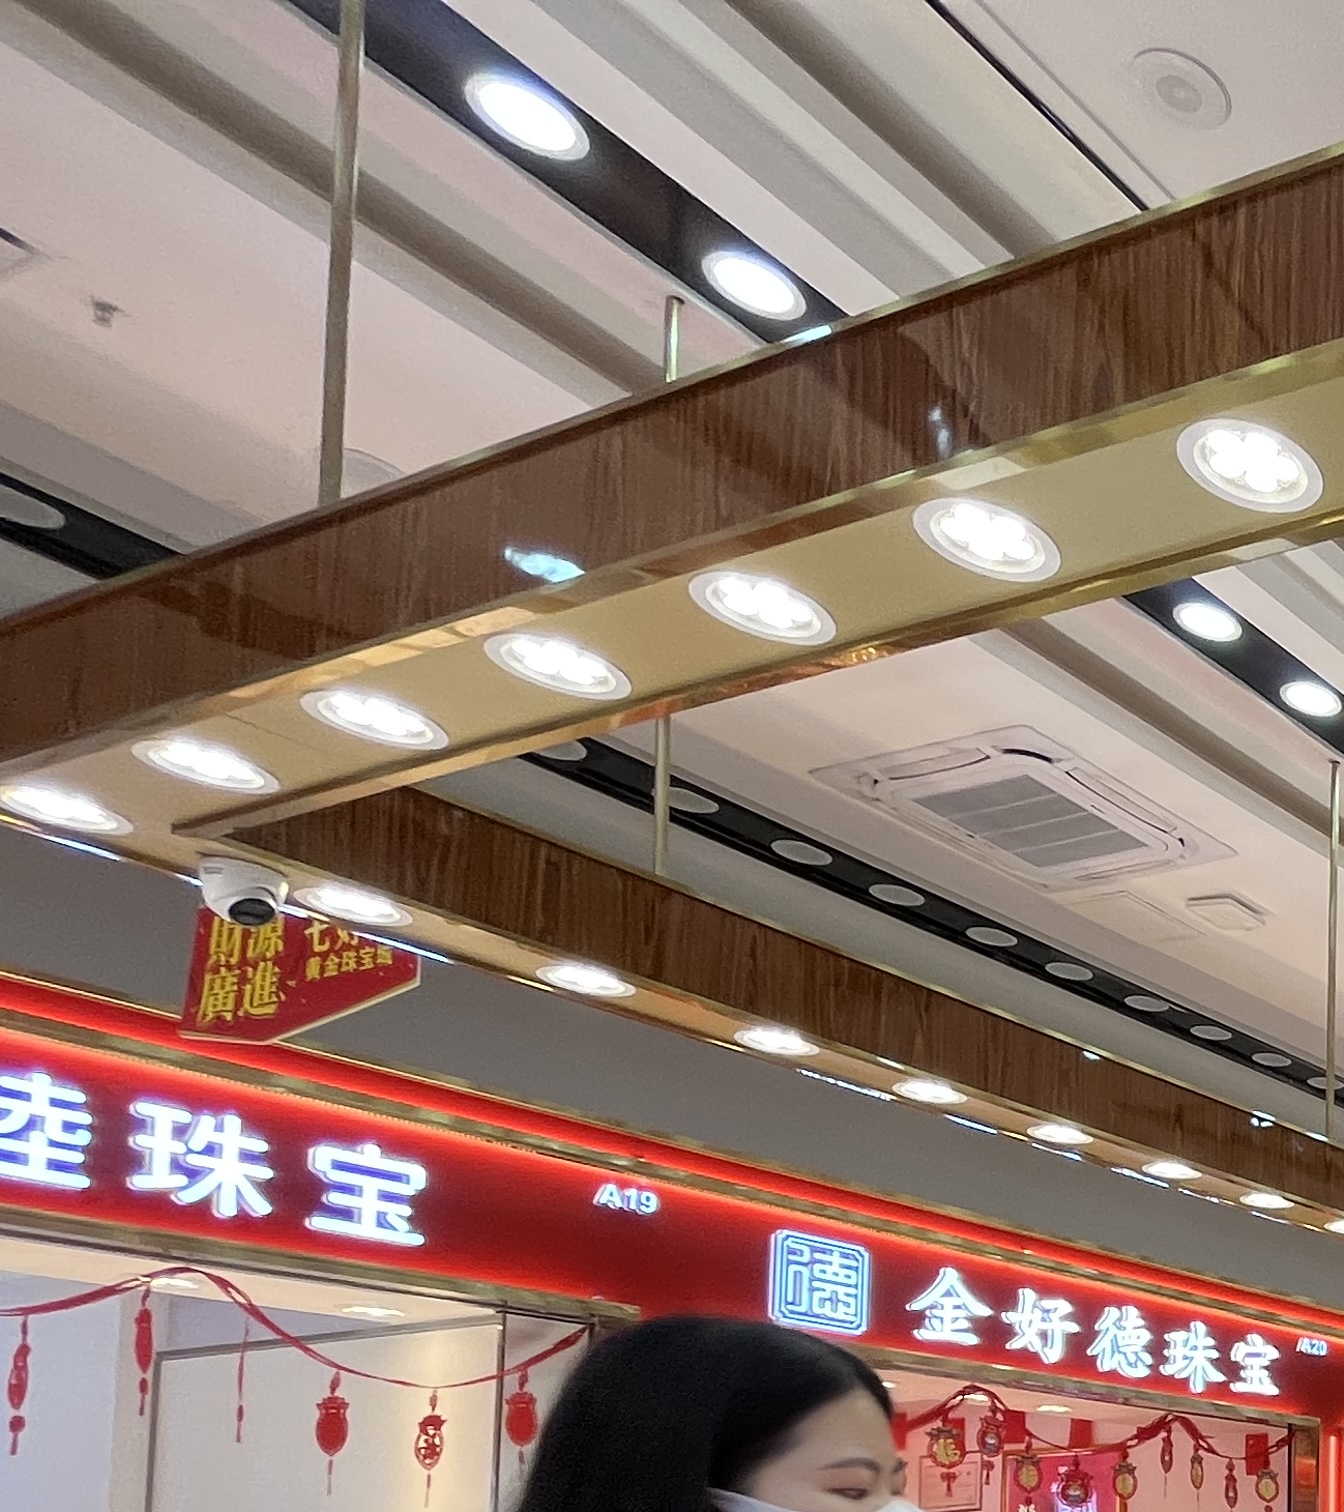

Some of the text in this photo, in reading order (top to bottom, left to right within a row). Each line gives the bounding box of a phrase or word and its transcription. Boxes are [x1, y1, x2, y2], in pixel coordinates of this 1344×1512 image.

[595, 1183, 660, 1215] A19
[906, 1266, 1281, 1396] 金好德珠宝
